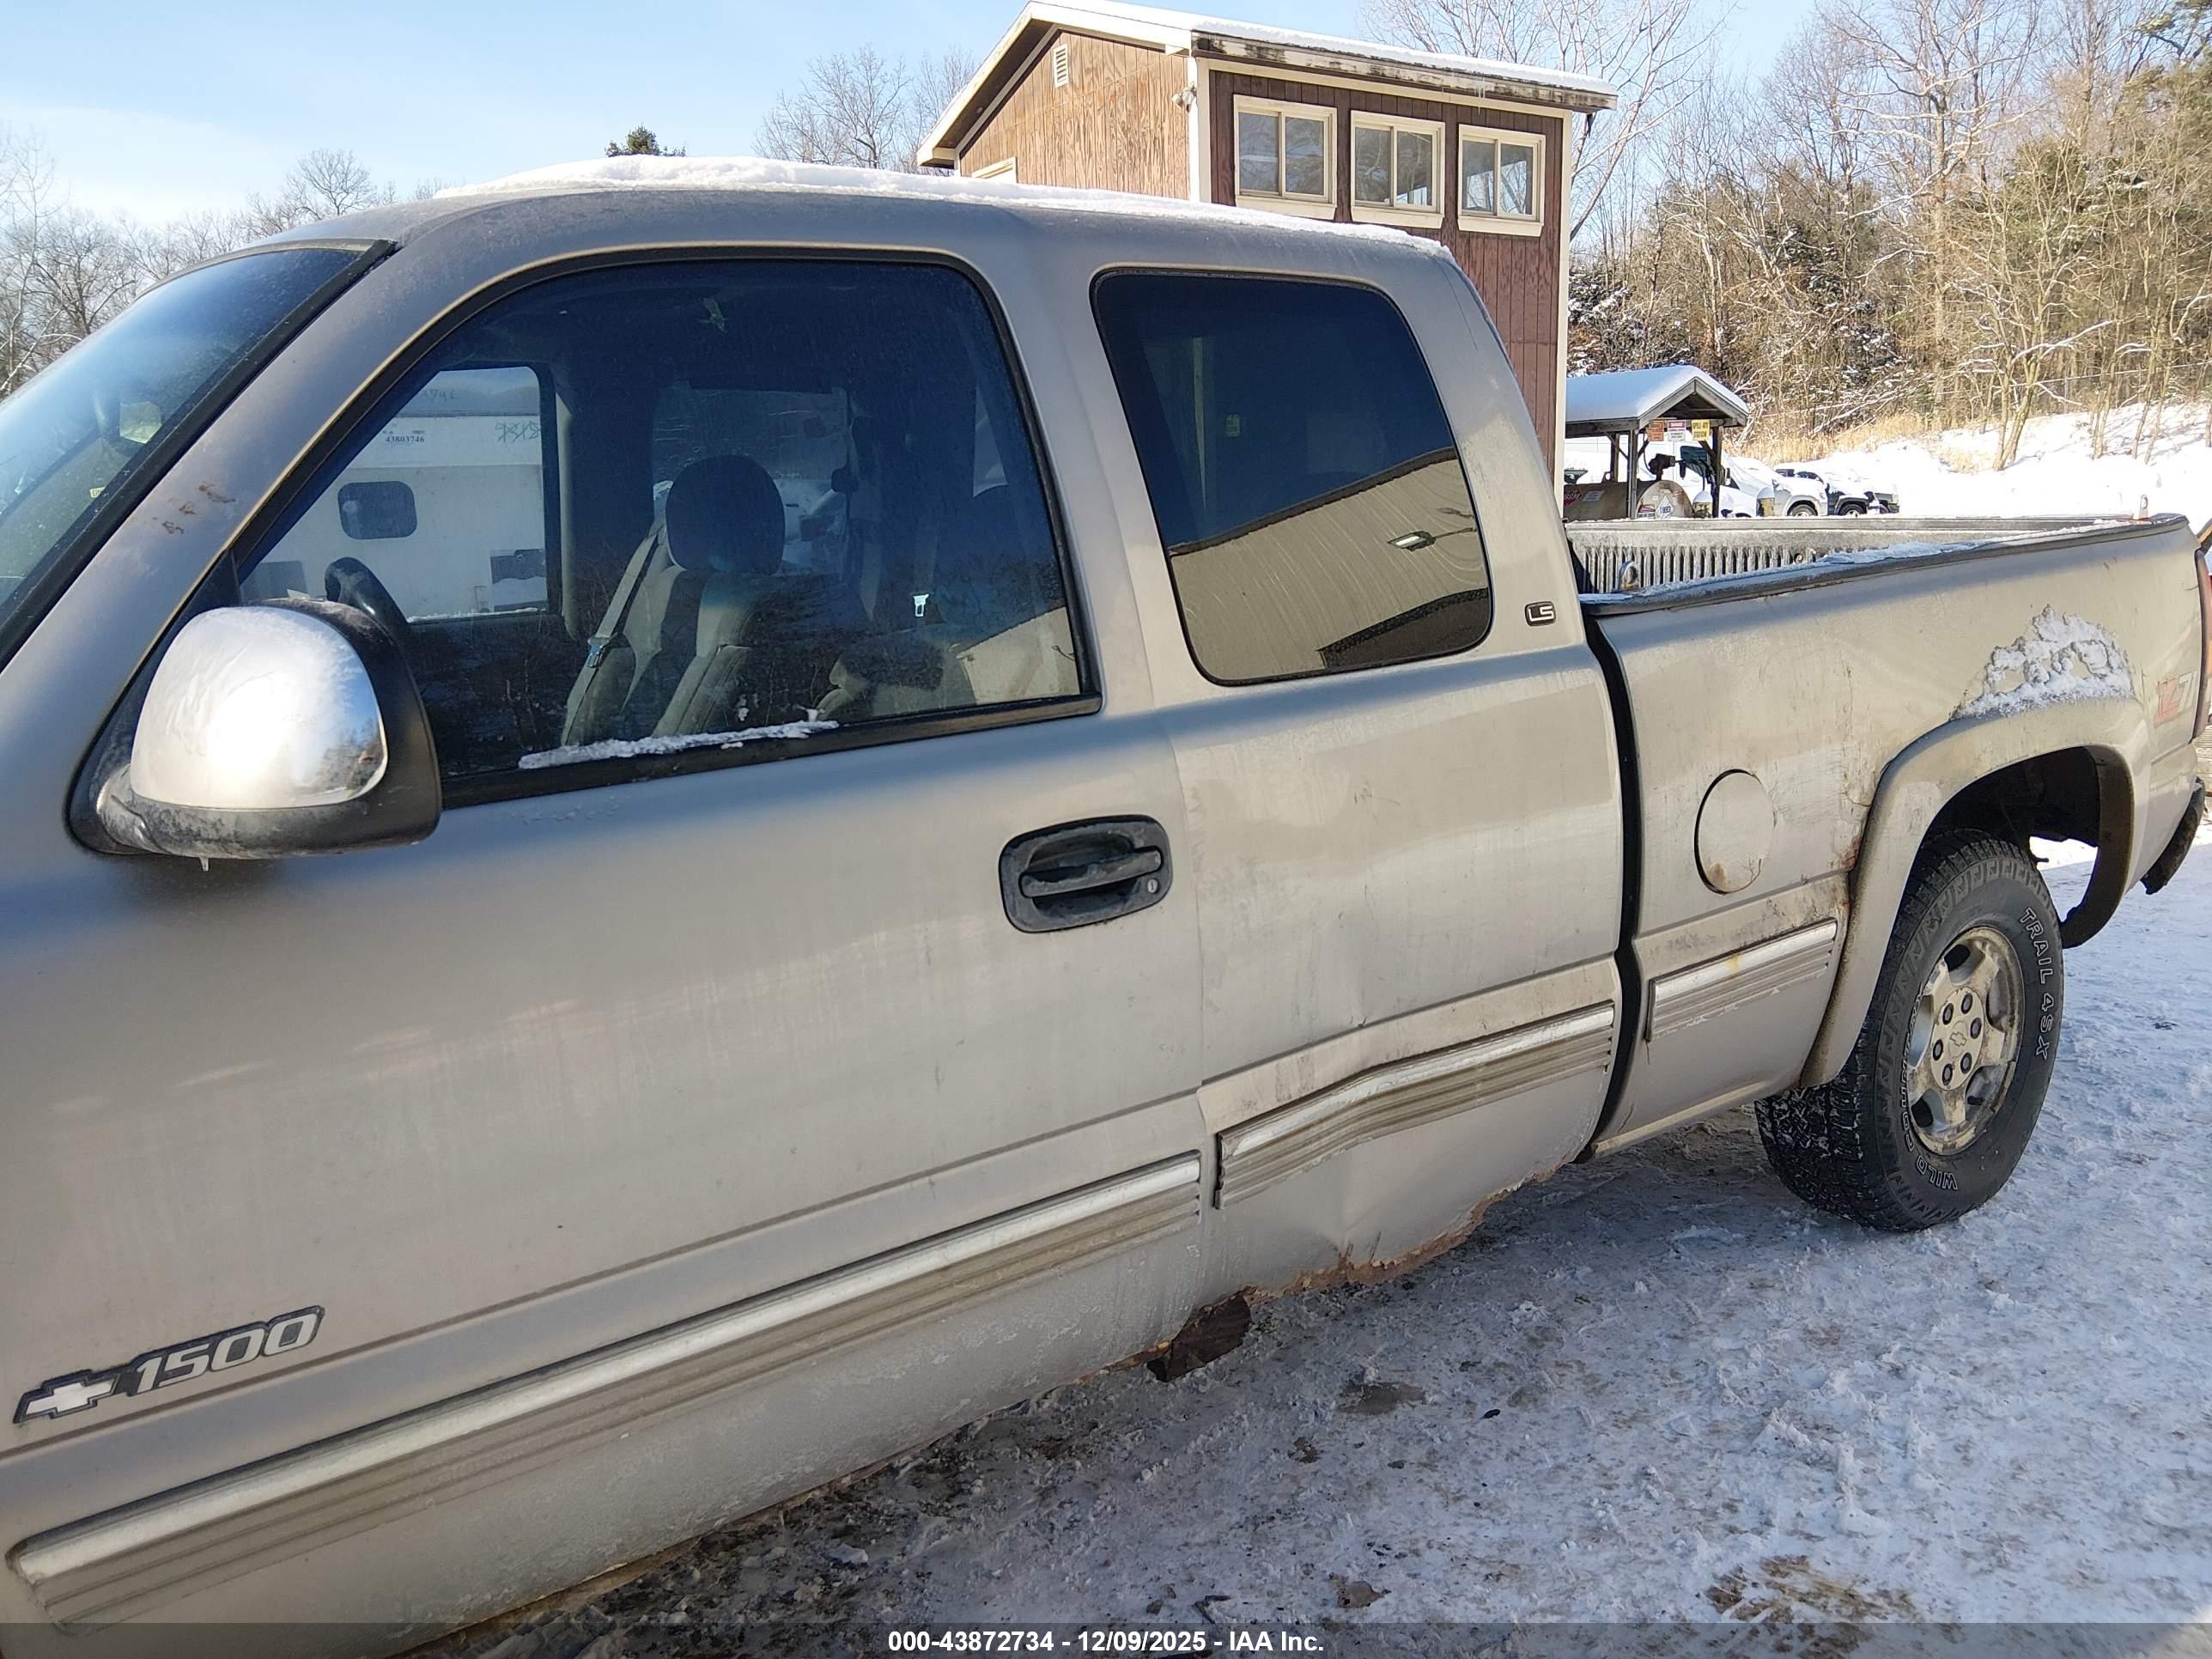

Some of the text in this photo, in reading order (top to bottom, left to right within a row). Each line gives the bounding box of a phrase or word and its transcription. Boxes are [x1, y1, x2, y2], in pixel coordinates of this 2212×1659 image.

[1527, 605, 1555, 623] LS
[2020, 907, 2055, 1061] TRAIL 4SX
[1916, 1153, 1959, 1190] WILD
[134, 1309, 323, 1395] 1500
